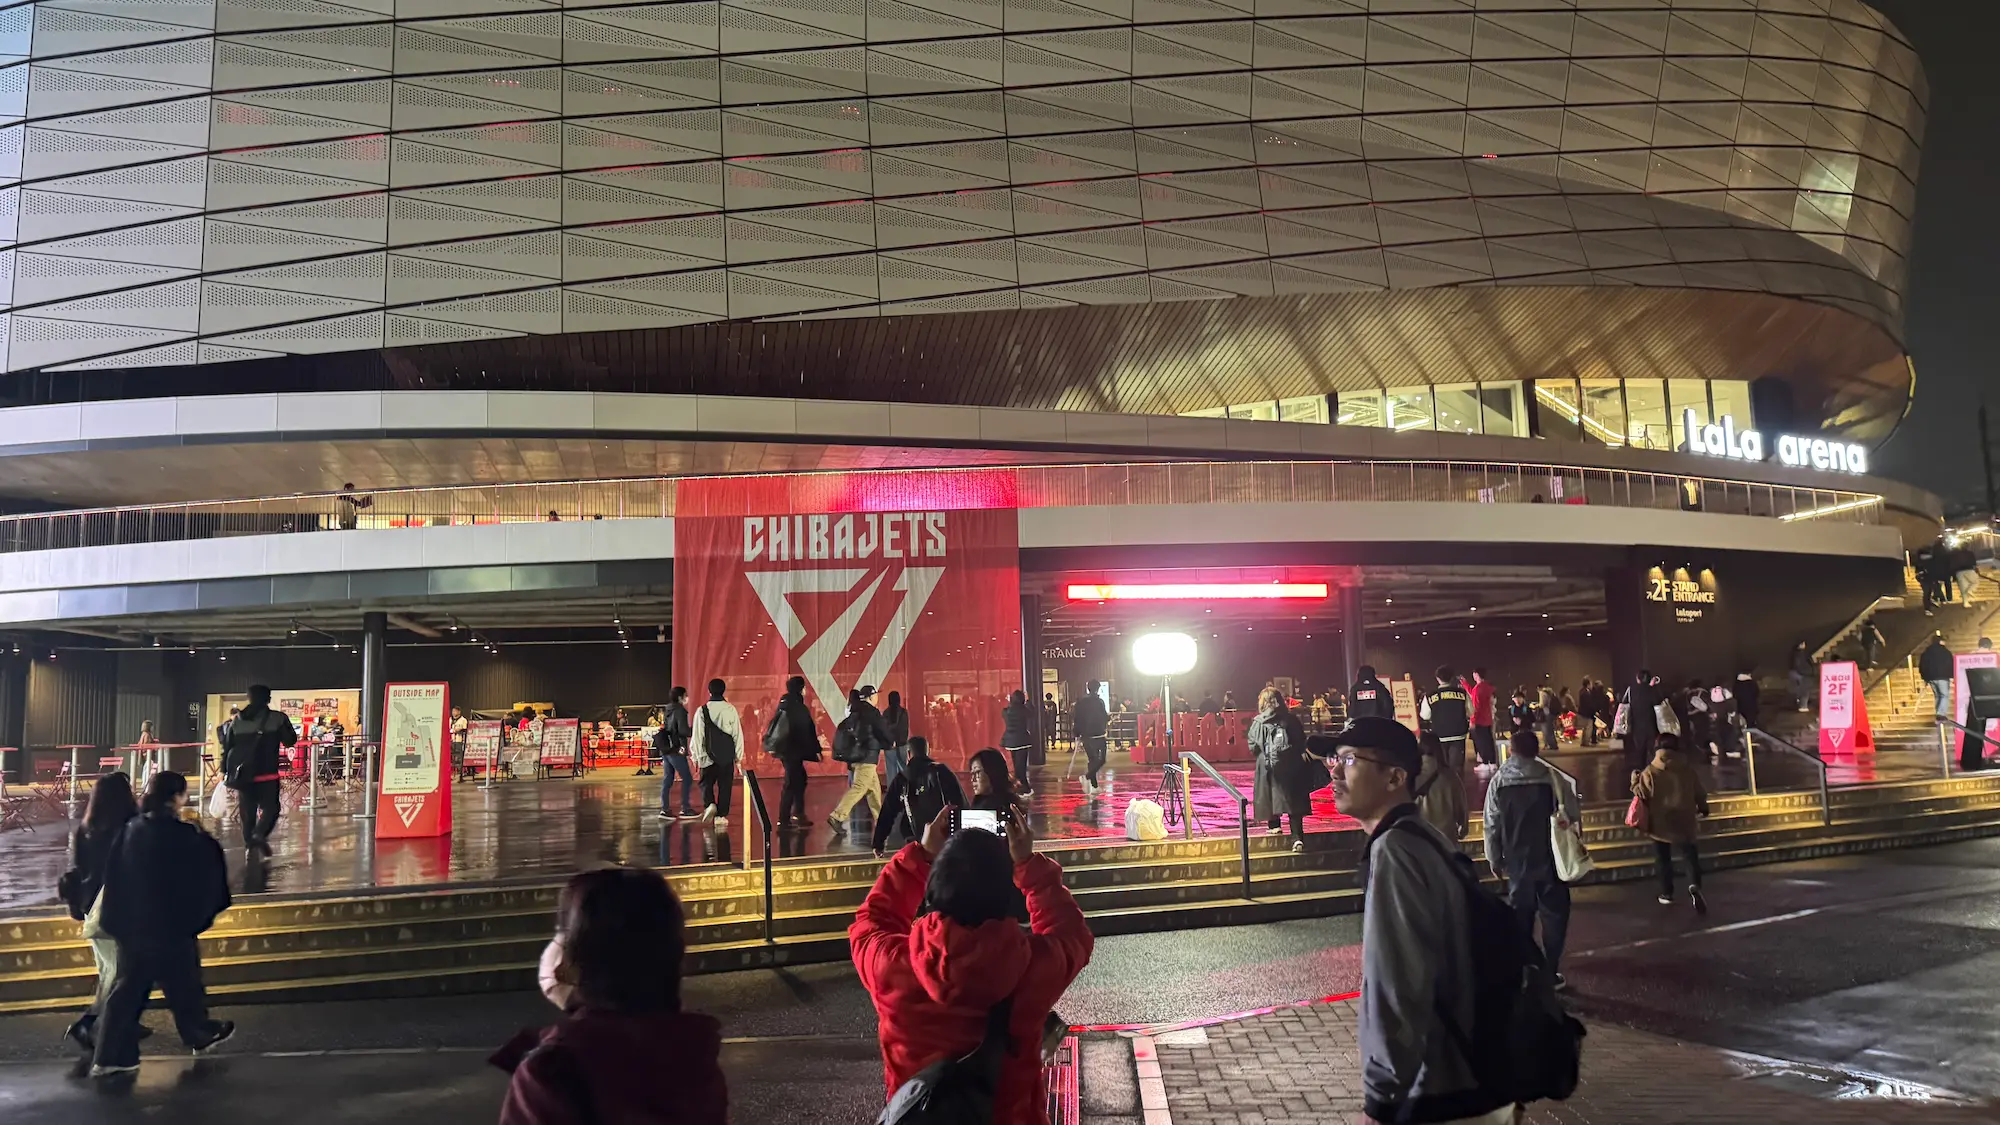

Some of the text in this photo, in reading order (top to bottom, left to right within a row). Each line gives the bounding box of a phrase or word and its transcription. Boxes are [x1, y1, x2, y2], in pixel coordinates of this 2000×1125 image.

[1684, 408, 1866, 474] LaLa arena
[743, 512, 947, 563] CHIBAJETS
[1651, 578, 1700, 601] 2F STAND
[1673, 591, 1715, 603] ENTRANCE
[1043, 648, 1087, 659] TRANCE
[393, 688, 440, 698] OUTSIDE MAP
[1828, 683, 1848, 695] 2F
[1428, 691, 1466, 705] LOS ANGELES
